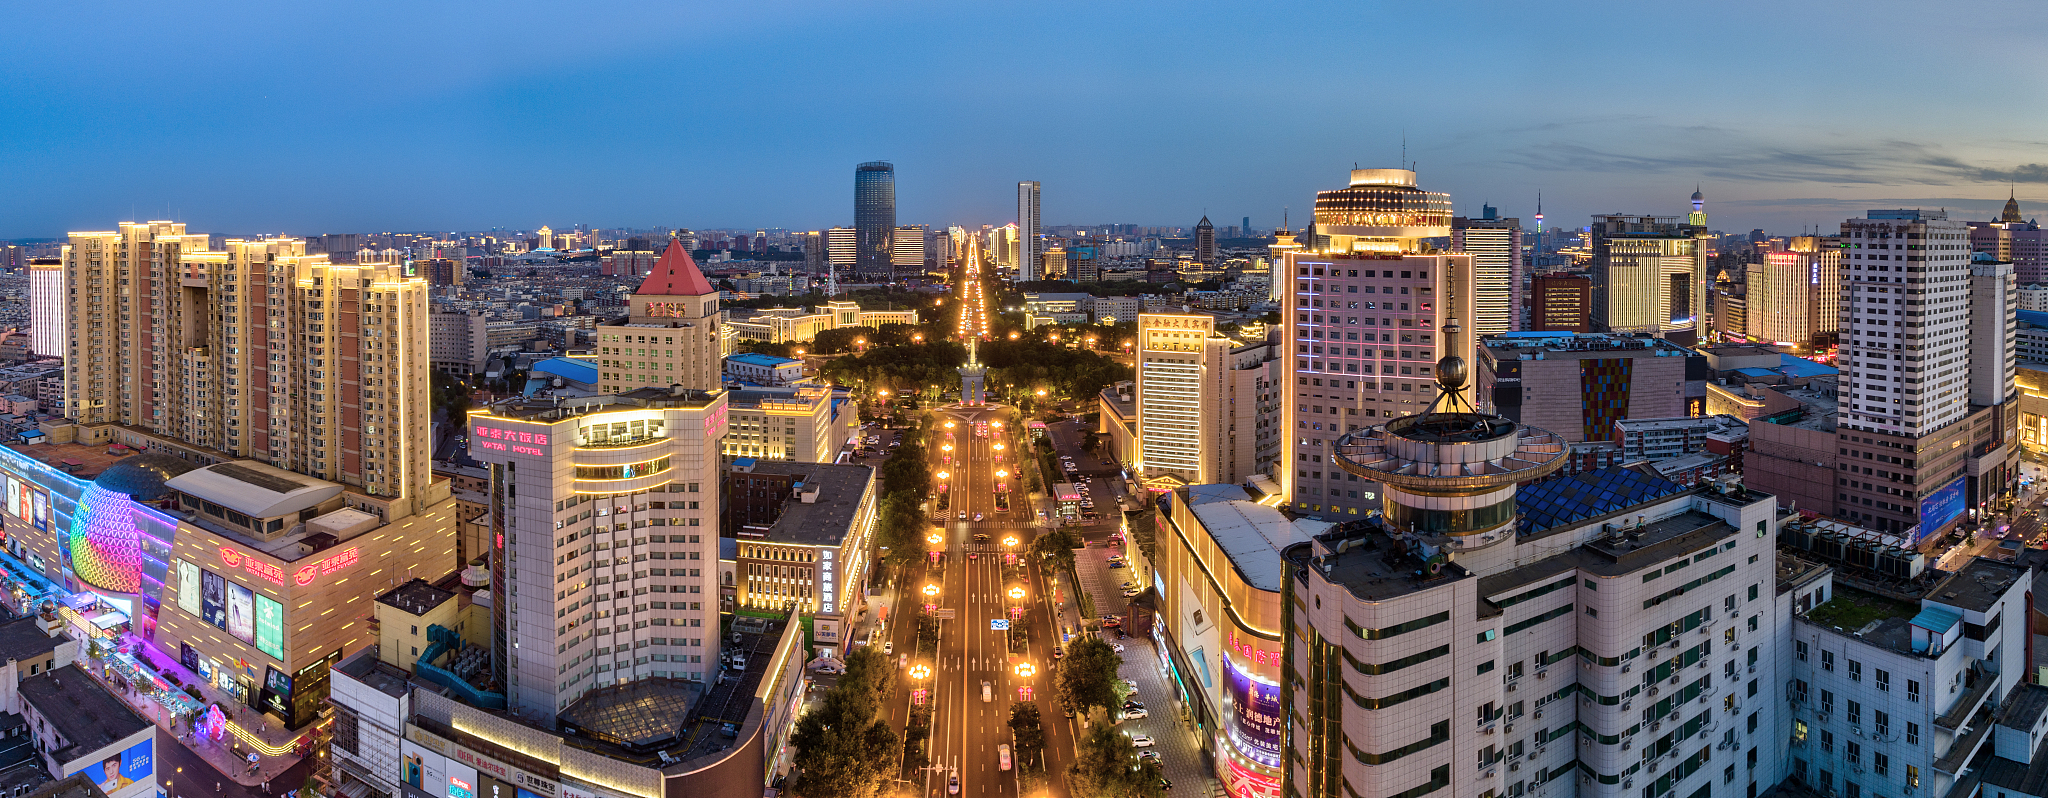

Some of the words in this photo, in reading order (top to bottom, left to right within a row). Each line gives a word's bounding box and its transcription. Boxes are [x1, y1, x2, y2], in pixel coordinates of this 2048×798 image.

[476, 425, 548, 446] 亚泰大饭店
[481, 440, 507, 452] YATAI
[512, 444, 544, 457] HOTEL
[822, 550, 833, 613] 如家商旅酒店
